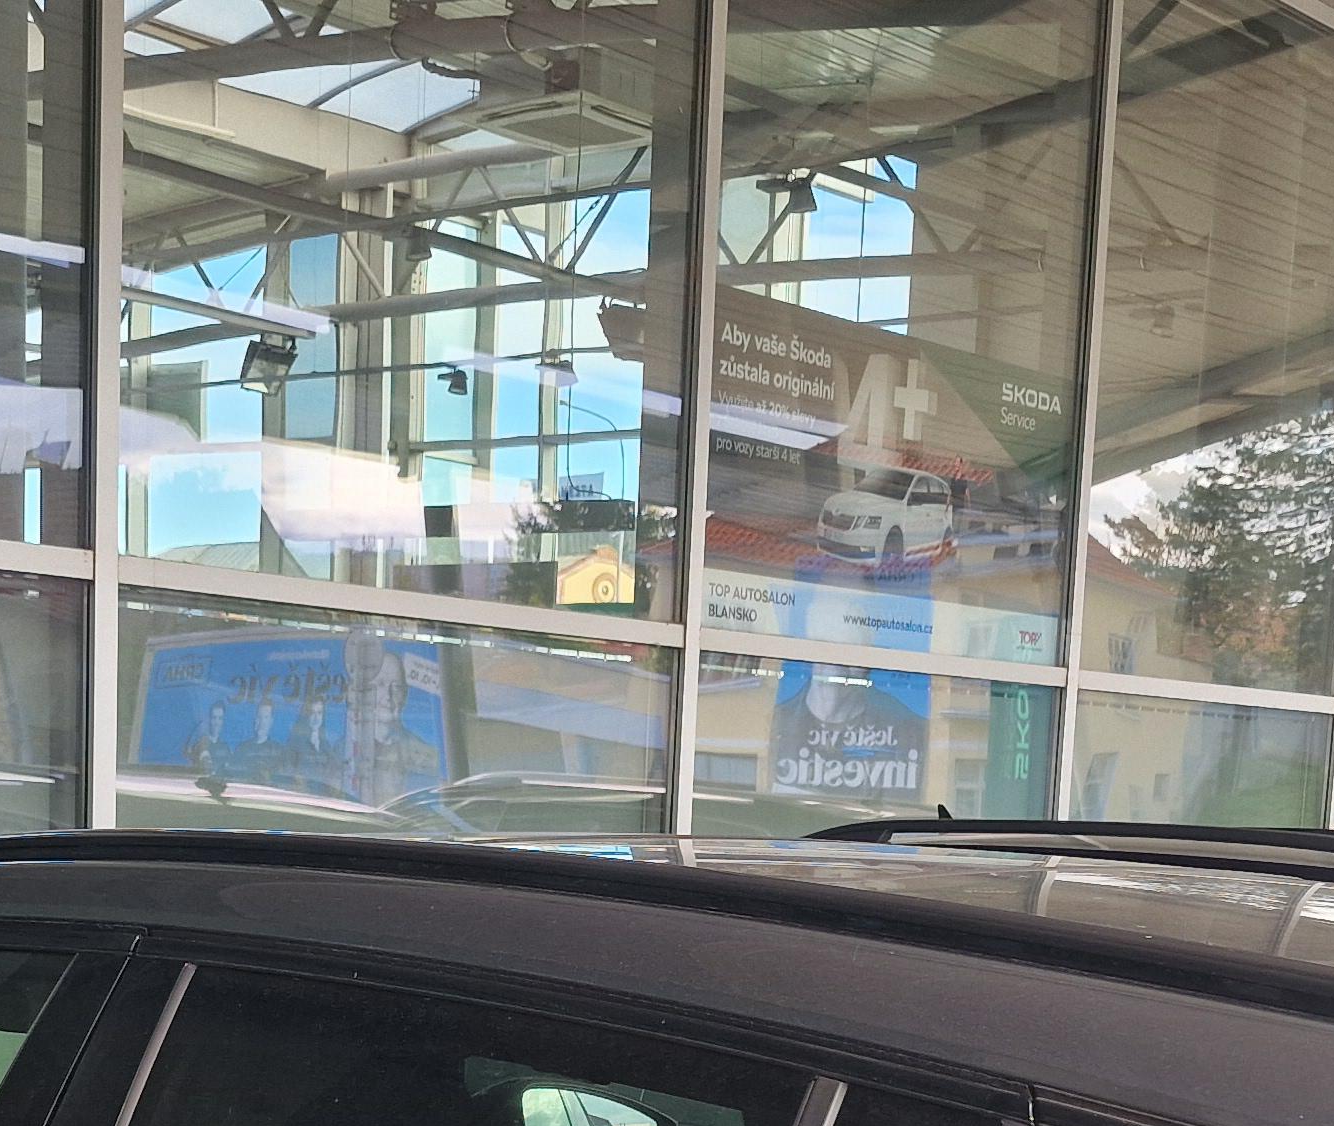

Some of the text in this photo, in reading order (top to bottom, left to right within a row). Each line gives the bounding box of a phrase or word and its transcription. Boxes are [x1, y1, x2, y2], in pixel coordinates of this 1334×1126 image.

[721, 321, 832, 368] Aby vaše Škoda
[720, 354, 835, 401] zůstala originální
[1000, 406, 1036, 431] Service
[715, 436, 732, 452] pro
[733, 440, 754, 459] vozy
[780, 448, 788, 462] 4
[708, 582, 796, 606] TOP AUTOSALON
[708, 603, 758, 622] BLANSKO
[843, 613, 933, 635] www.topautosalon.cz
